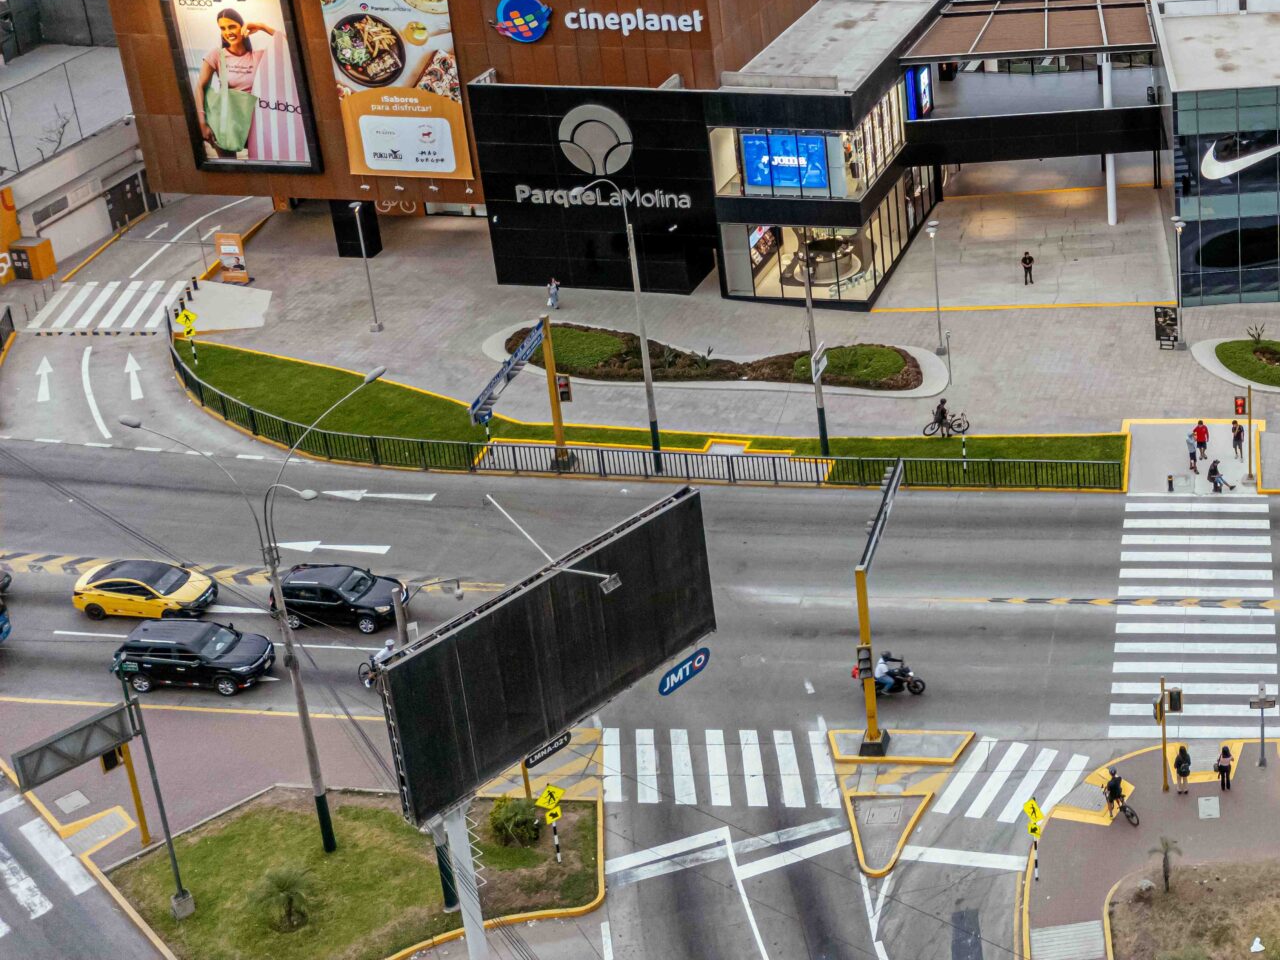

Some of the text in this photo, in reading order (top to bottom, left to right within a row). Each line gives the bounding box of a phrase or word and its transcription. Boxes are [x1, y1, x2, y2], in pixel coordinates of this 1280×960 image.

[564, 8, 704, 37] cineplanet
[392, 104, 431, 112] disfrutar!
[529, 735, 568, 764] LMNA-021
